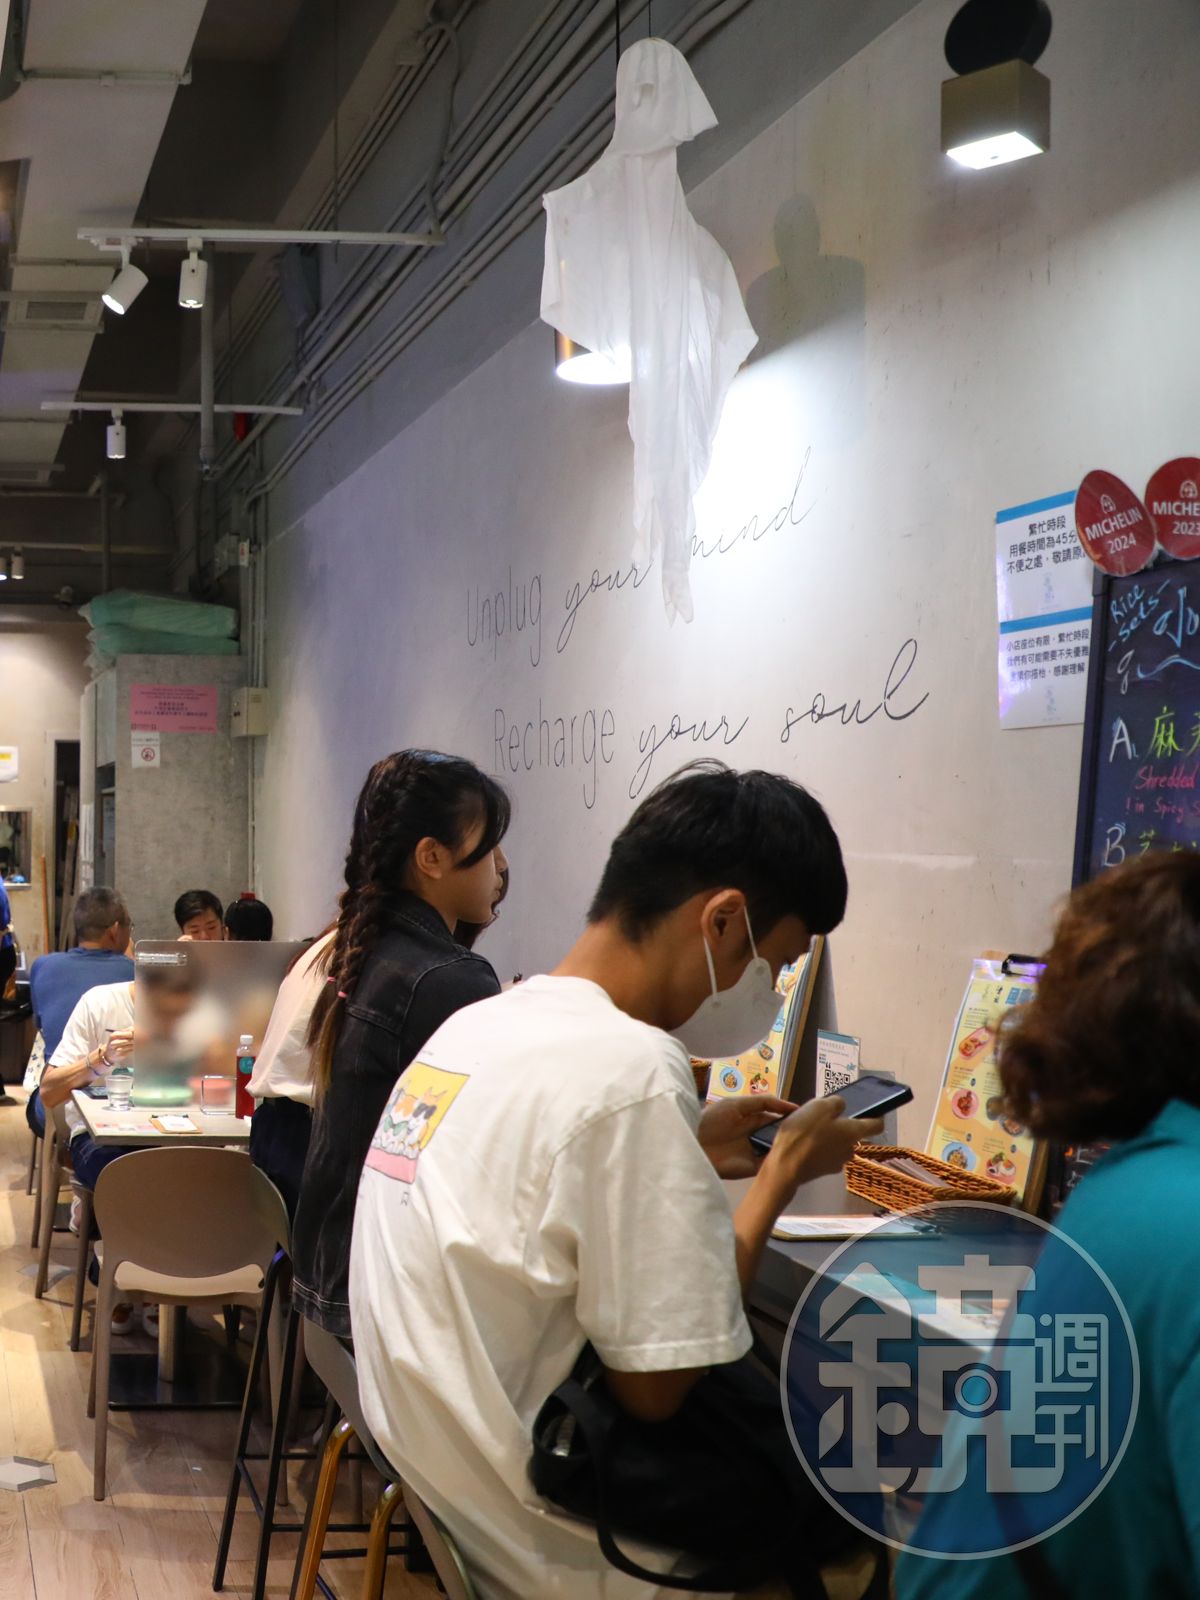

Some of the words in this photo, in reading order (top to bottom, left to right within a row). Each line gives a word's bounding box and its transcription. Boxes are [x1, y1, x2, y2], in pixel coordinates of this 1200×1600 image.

[1028, 515, 1066, 537] 繁忙時段
[1084, 506, 1143, 541] MICHELIN
[1007, 545, 1086, 574] 不便之處，敬請原
[1107, 531, 1137, 554] 2024
[467, 565, 542, 667] Unplug
[557, 560, 655, 654] your
[1110, 584, 1145, 624] Rice
[494, 698, 616, 809] Recharge
[628, 714, 749, 800] your
[780, 638, 930, 744] soul
[1109, 718, 1132, 763] A
[1135, 764, 1197, 790] Shredded
[1104, 826, 1126, 867] B
